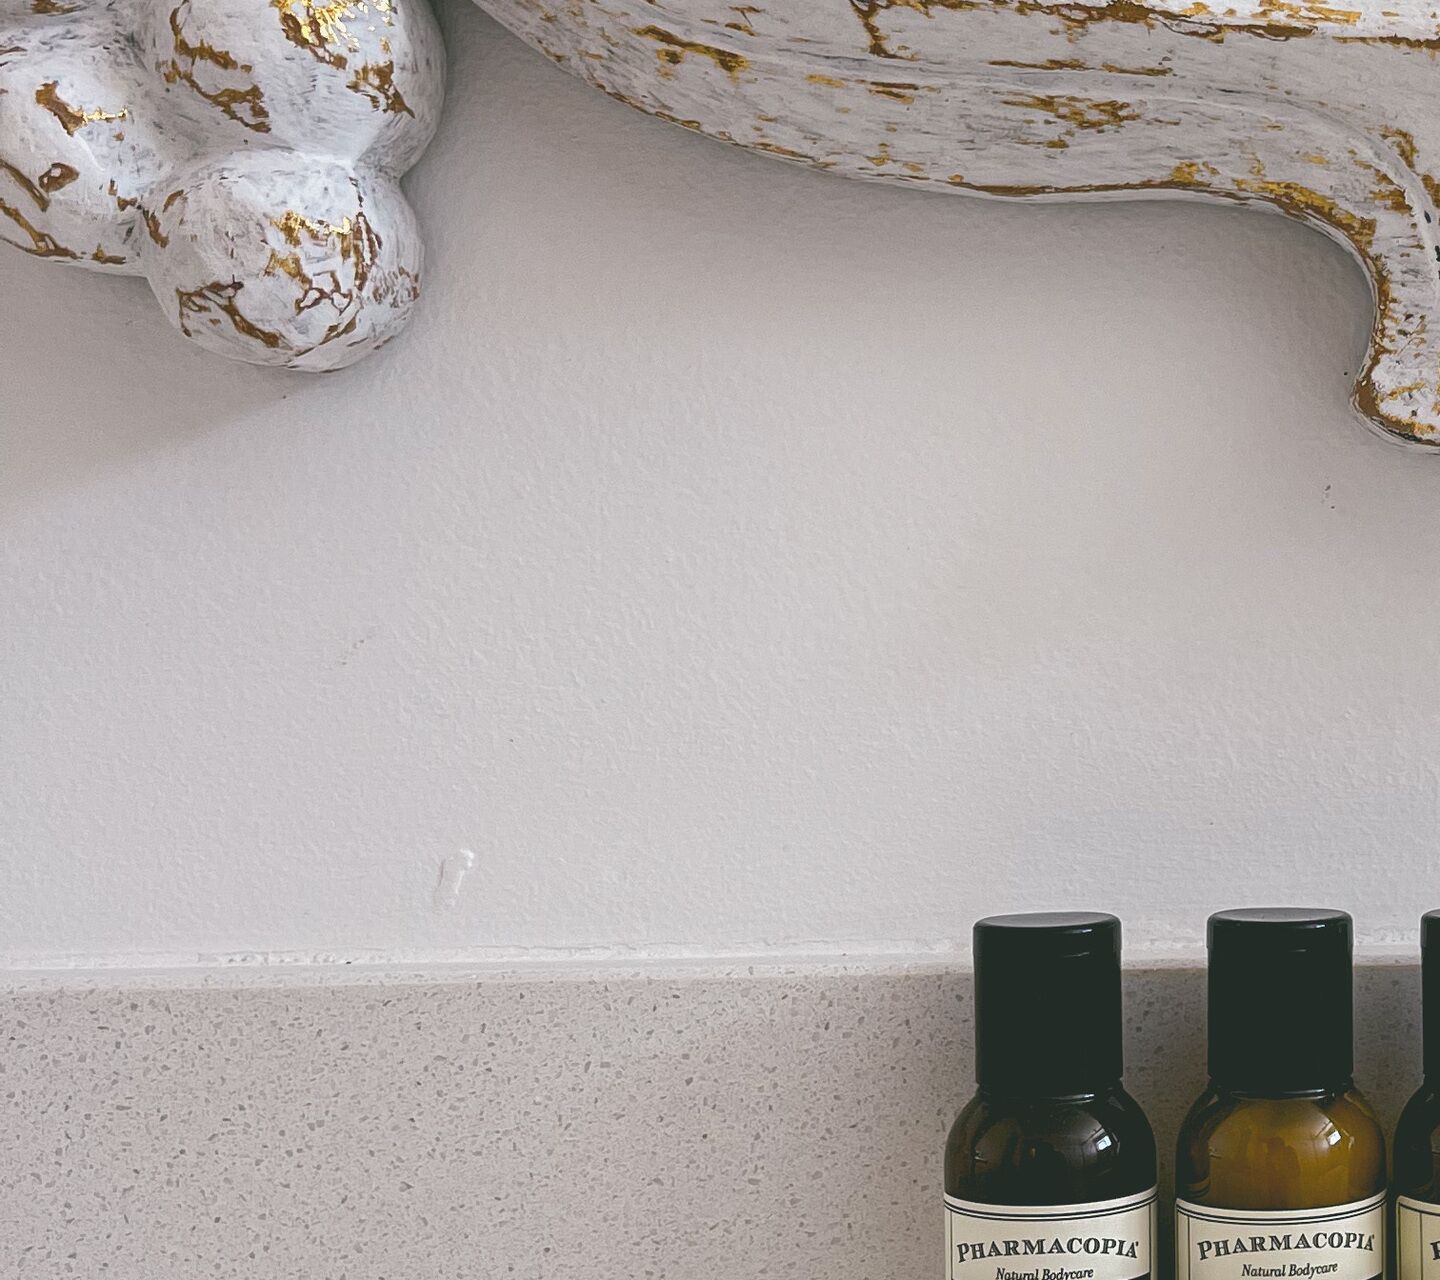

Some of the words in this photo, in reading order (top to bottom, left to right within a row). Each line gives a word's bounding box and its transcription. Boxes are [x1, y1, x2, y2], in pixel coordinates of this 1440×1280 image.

[957, 1237, 1137, 1263] PHARMACOPIA
[1197, 1232, 1374, 1260] PHARMACOPIA
[996, 1268, 1039, 1280] Natural
[1242, 1264, 1286, 1277] Natural
[1289, 1262, 1338, 1279] Bodycare
